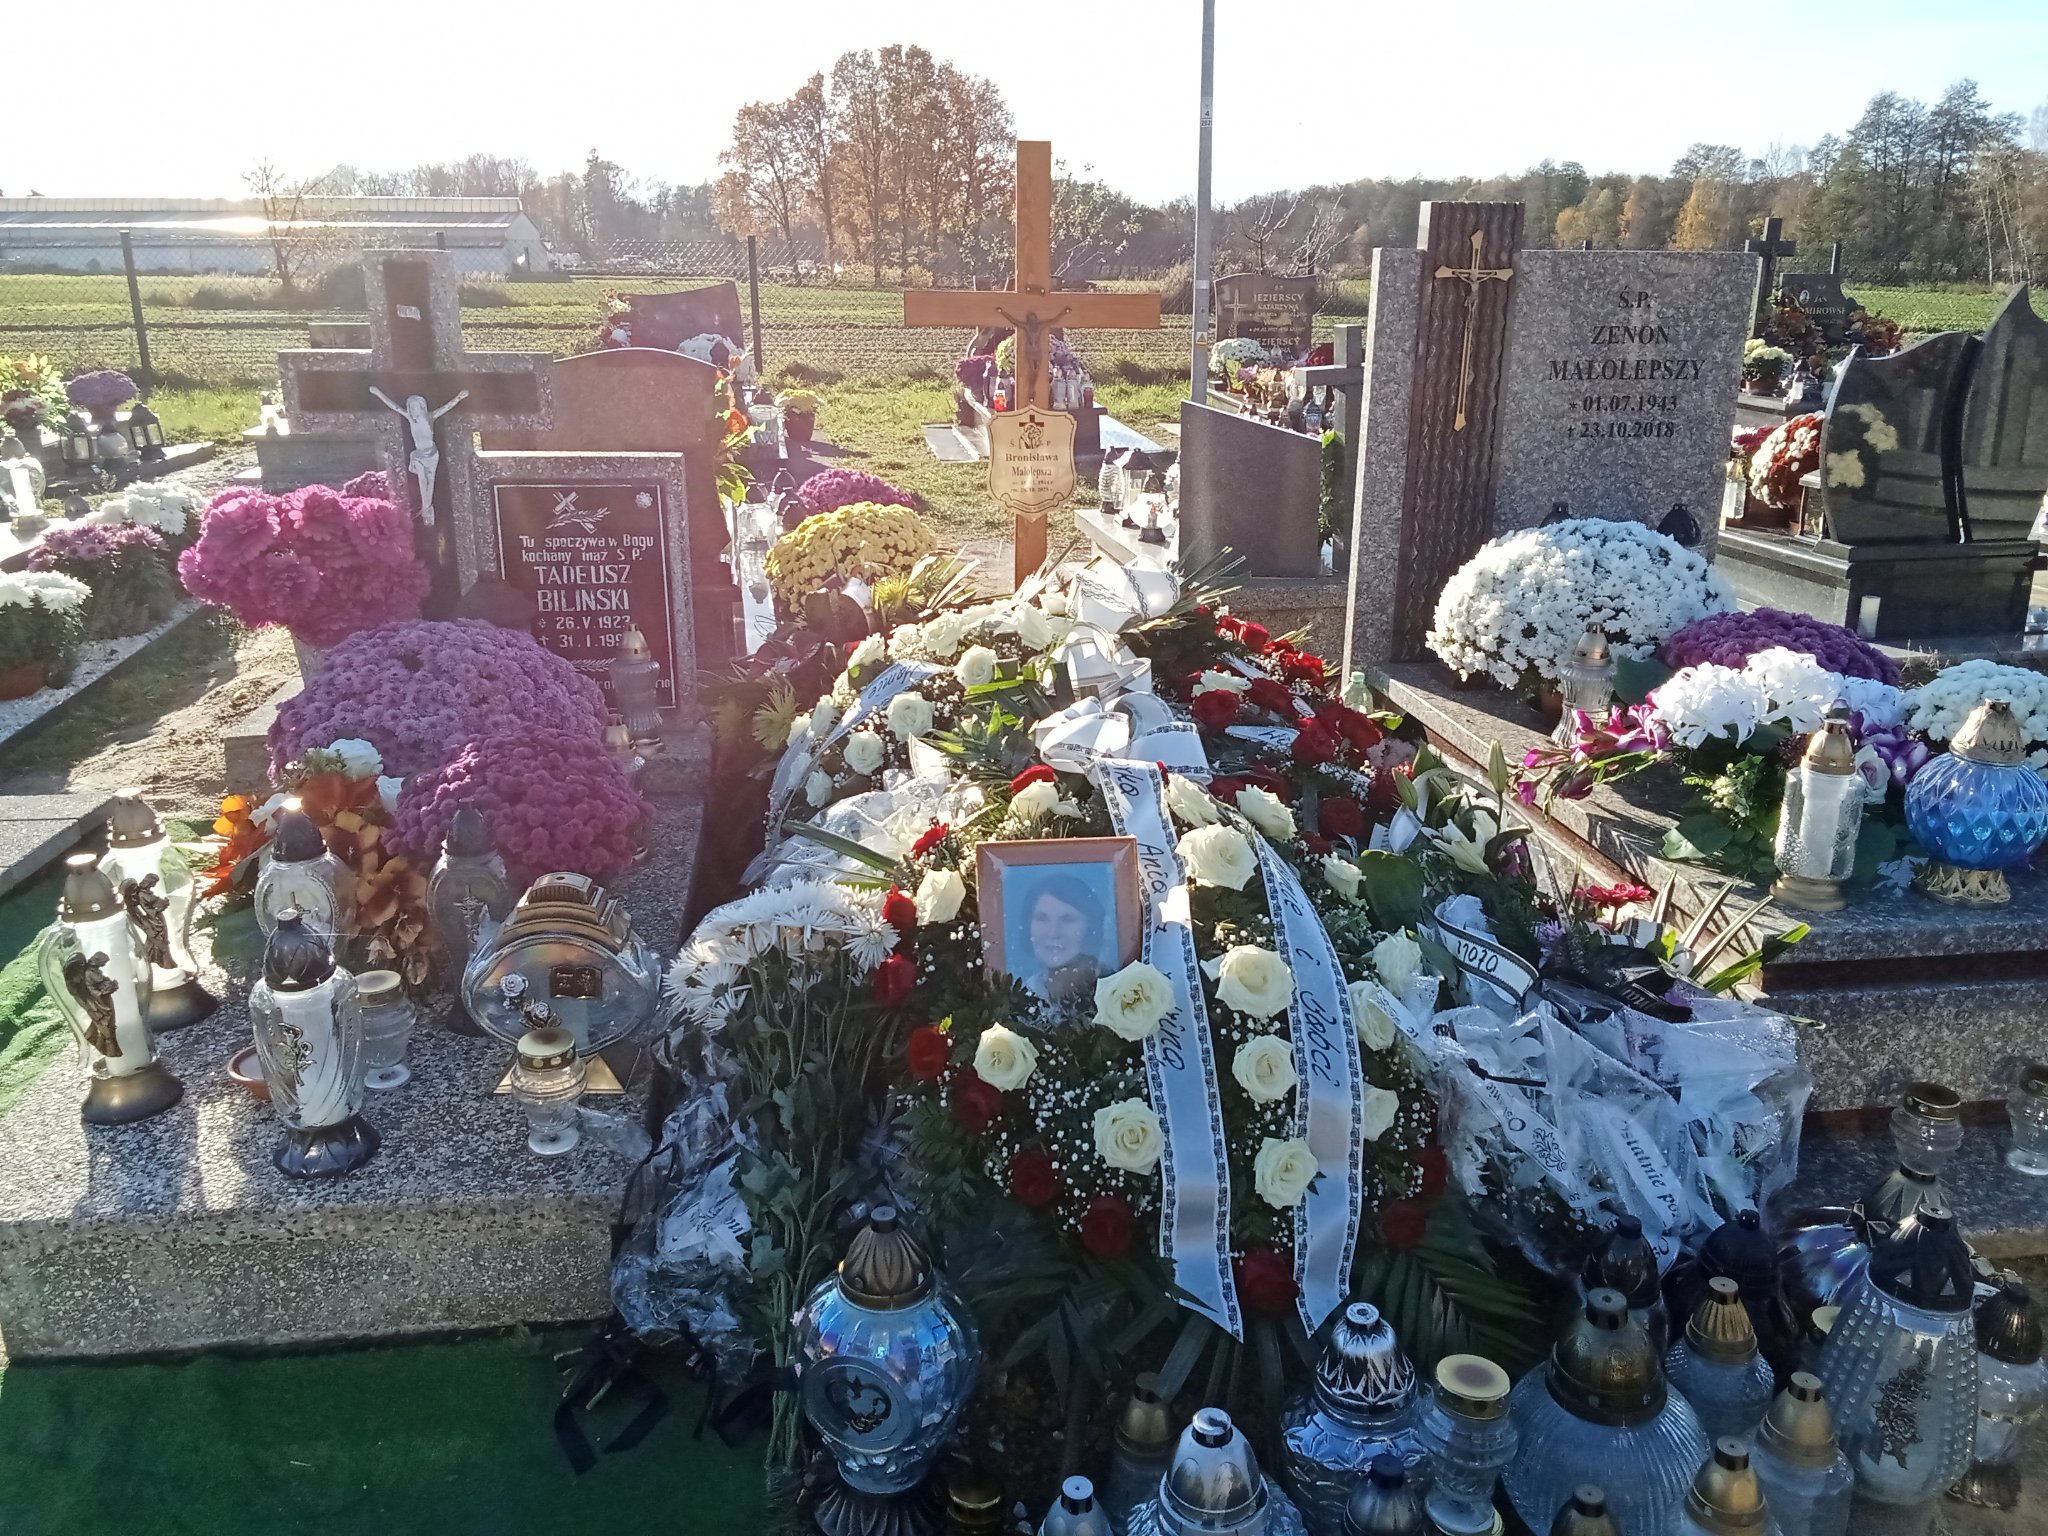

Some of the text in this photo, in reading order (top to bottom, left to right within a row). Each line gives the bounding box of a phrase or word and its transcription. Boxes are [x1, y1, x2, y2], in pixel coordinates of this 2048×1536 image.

[1590, 324, 1670, 345] ZENON
[519, 534, 654, 551] Tu spoczywa w Bogu
[522, 549, 571, 564] kochany
[533, 564, 632, 585] TADEUSZ
[1299, 990, 1341, 1088] Babci
